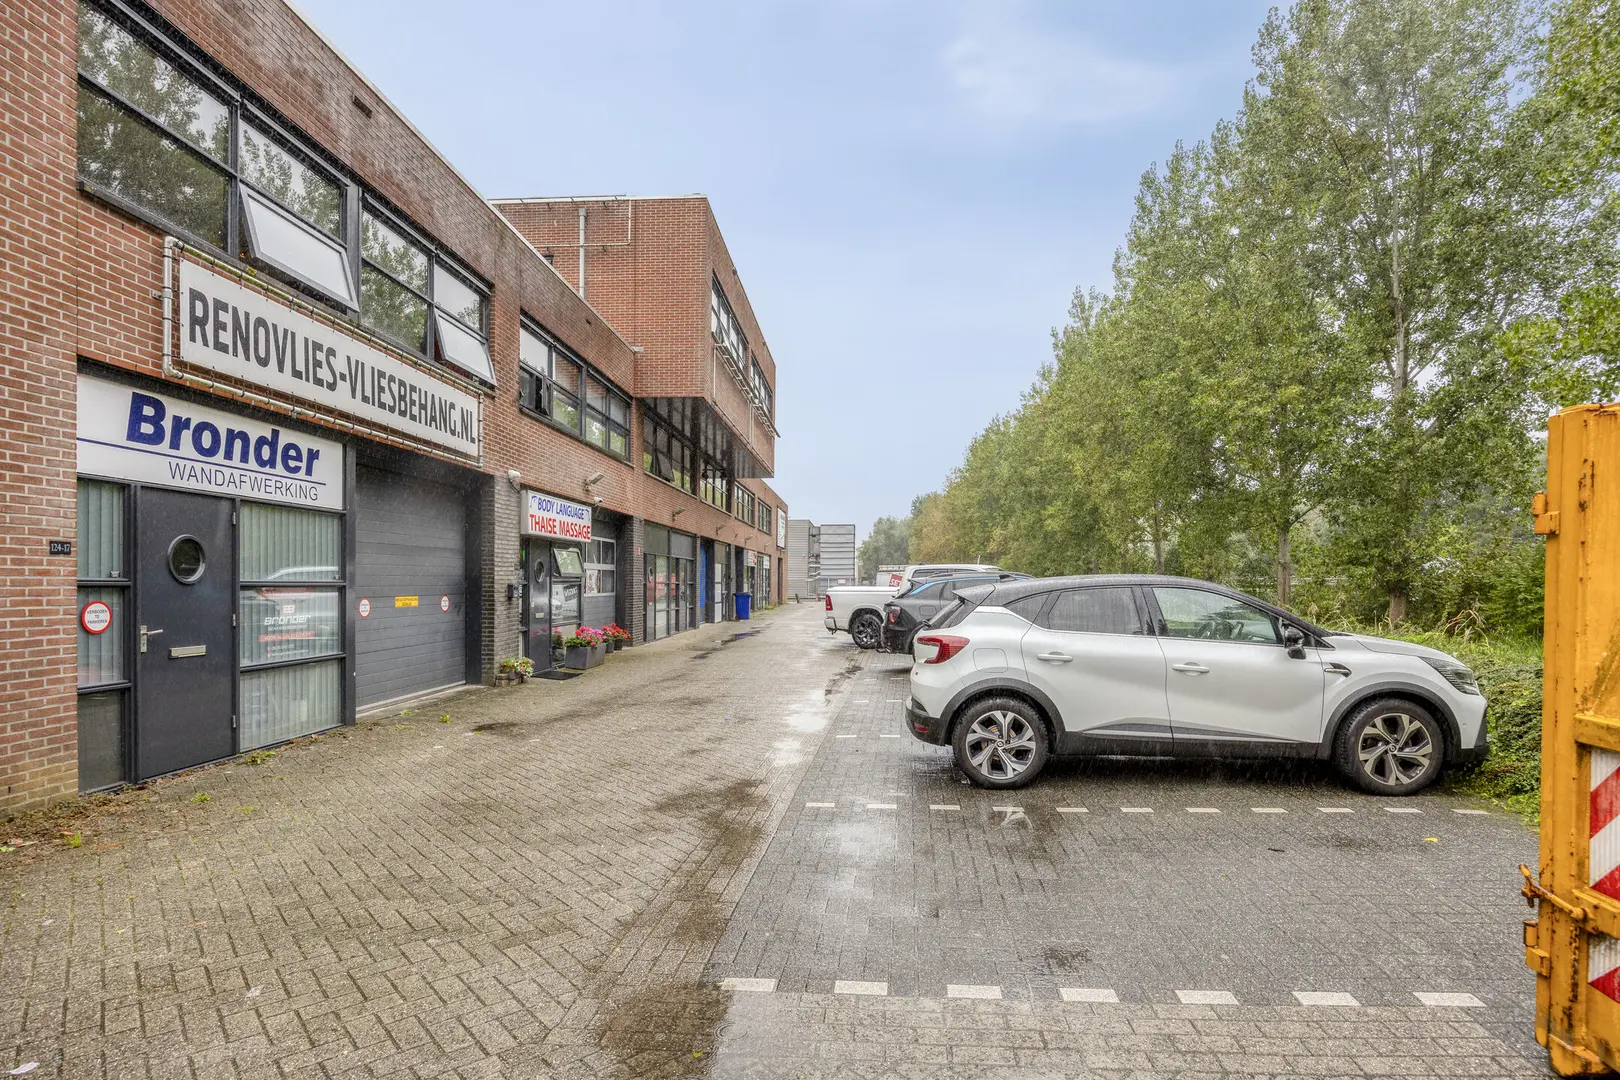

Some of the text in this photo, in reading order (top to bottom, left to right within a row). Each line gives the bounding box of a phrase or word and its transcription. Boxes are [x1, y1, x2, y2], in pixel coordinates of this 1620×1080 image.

[189, 287, 476, 444] RENOVLIES-VLIESBEHANG.NL
[126, 391, 320, 477] Bronder
[168, 461, 318, 501] WANDAFWERKING
[537, 498, 584, 520] BODY LANGUAGE
[529, 514, 591, 540] THAISE MASSAGE
[51, 543, 70, 552] 124-17
